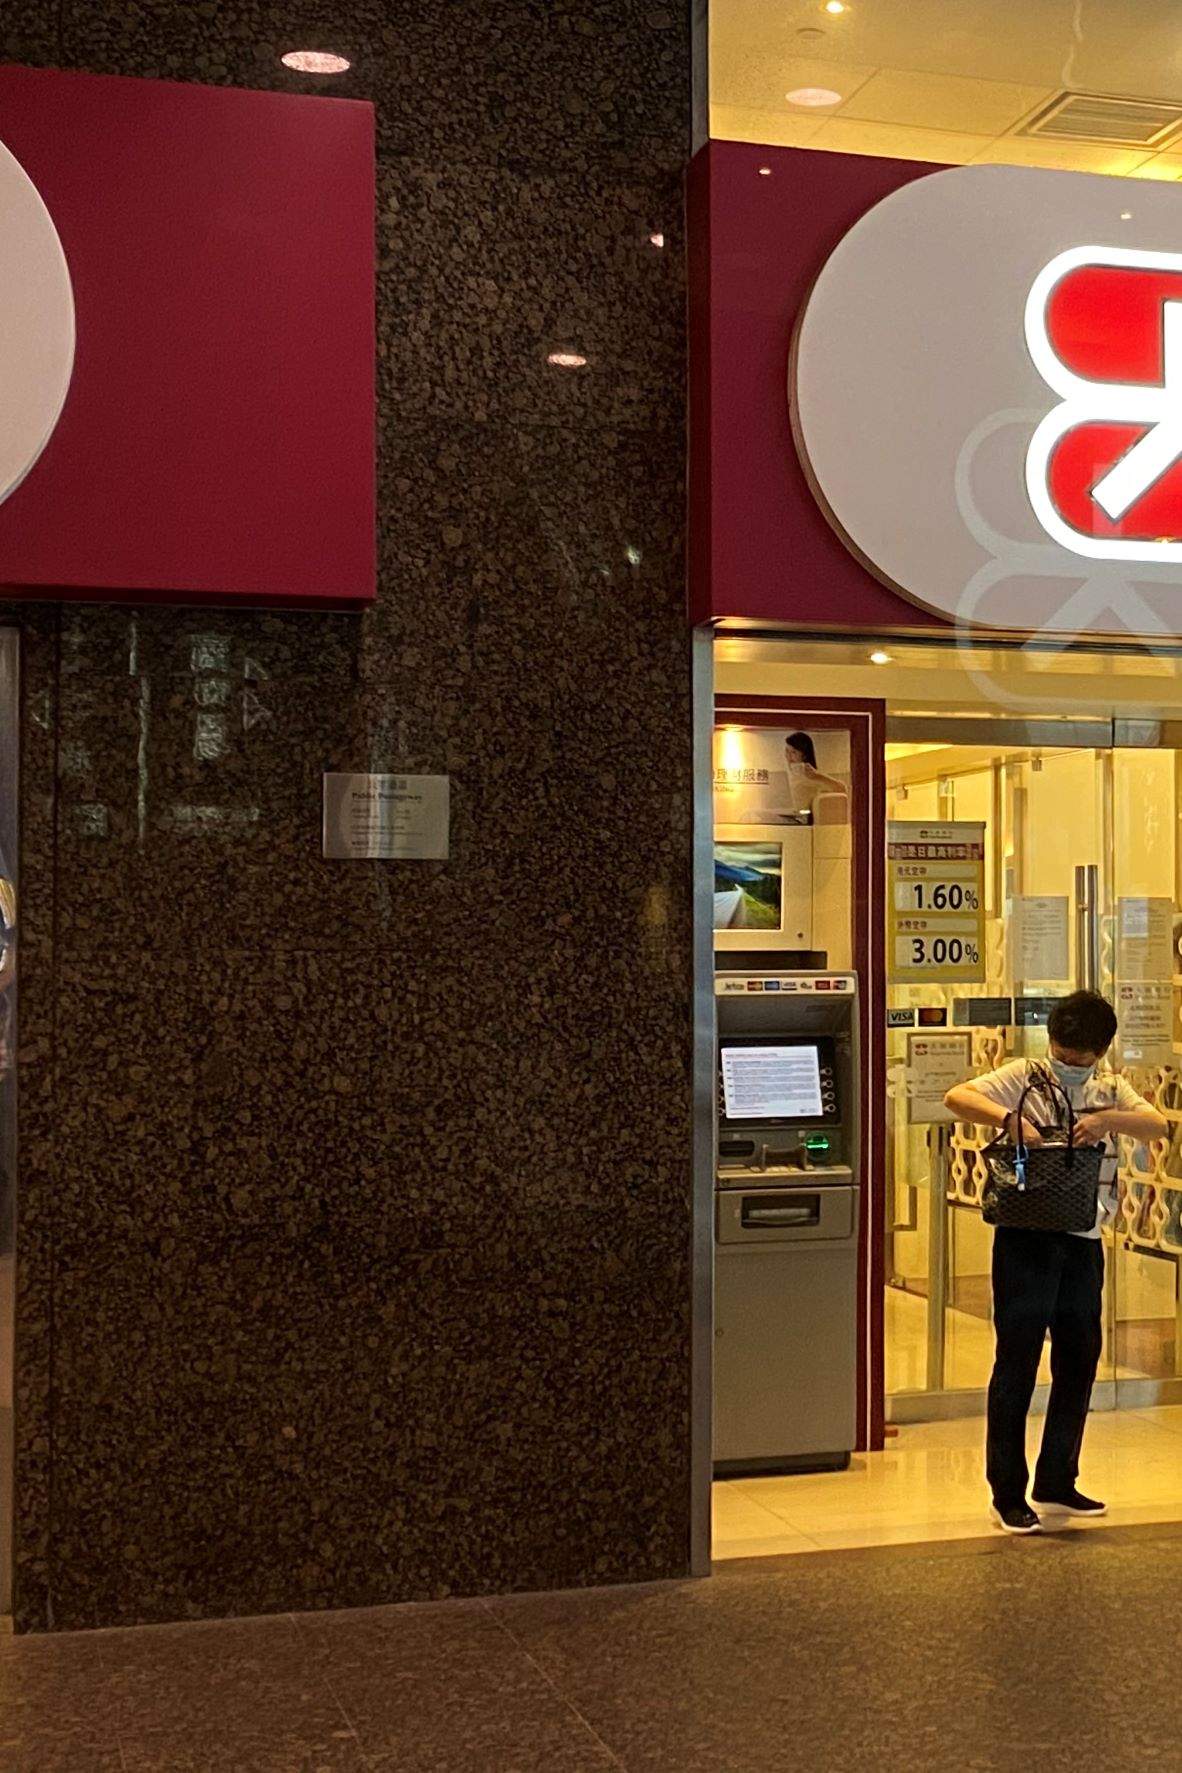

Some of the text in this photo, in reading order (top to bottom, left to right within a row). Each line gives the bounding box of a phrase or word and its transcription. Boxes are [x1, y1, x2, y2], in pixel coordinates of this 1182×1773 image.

[913, 884, 980, 910] 1.60%
[911, 938, 980, 964] 3.00%
[891, 1012, 914, 1021] VISA
